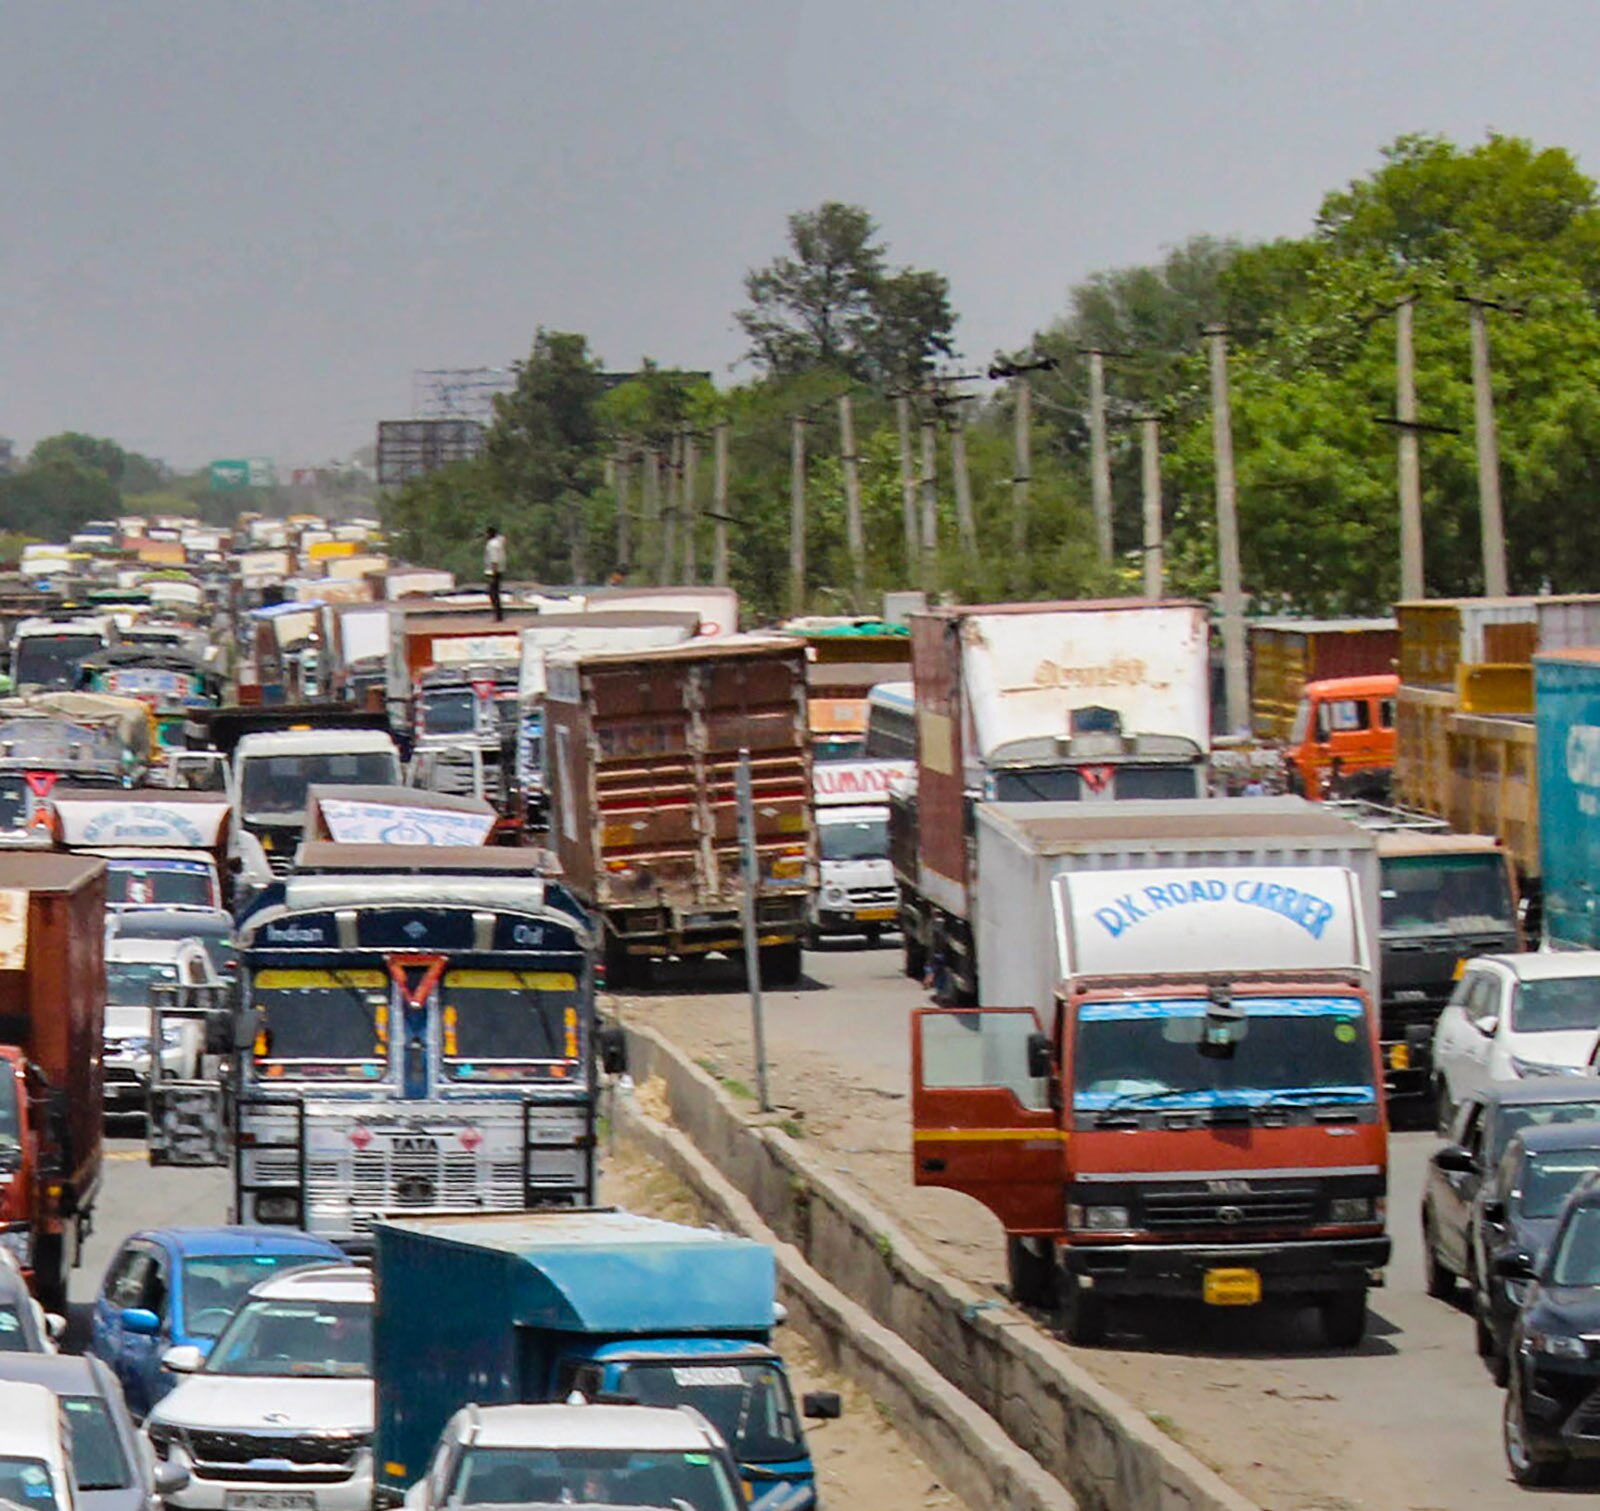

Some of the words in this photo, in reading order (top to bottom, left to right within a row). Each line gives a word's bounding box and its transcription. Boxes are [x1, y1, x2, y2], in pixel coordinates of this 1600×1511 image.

[1143, 879, 1227, 910] ROAD
[1233, 880, 1334, 940] CARRIER
[266, 924, 324, 942] Indian
